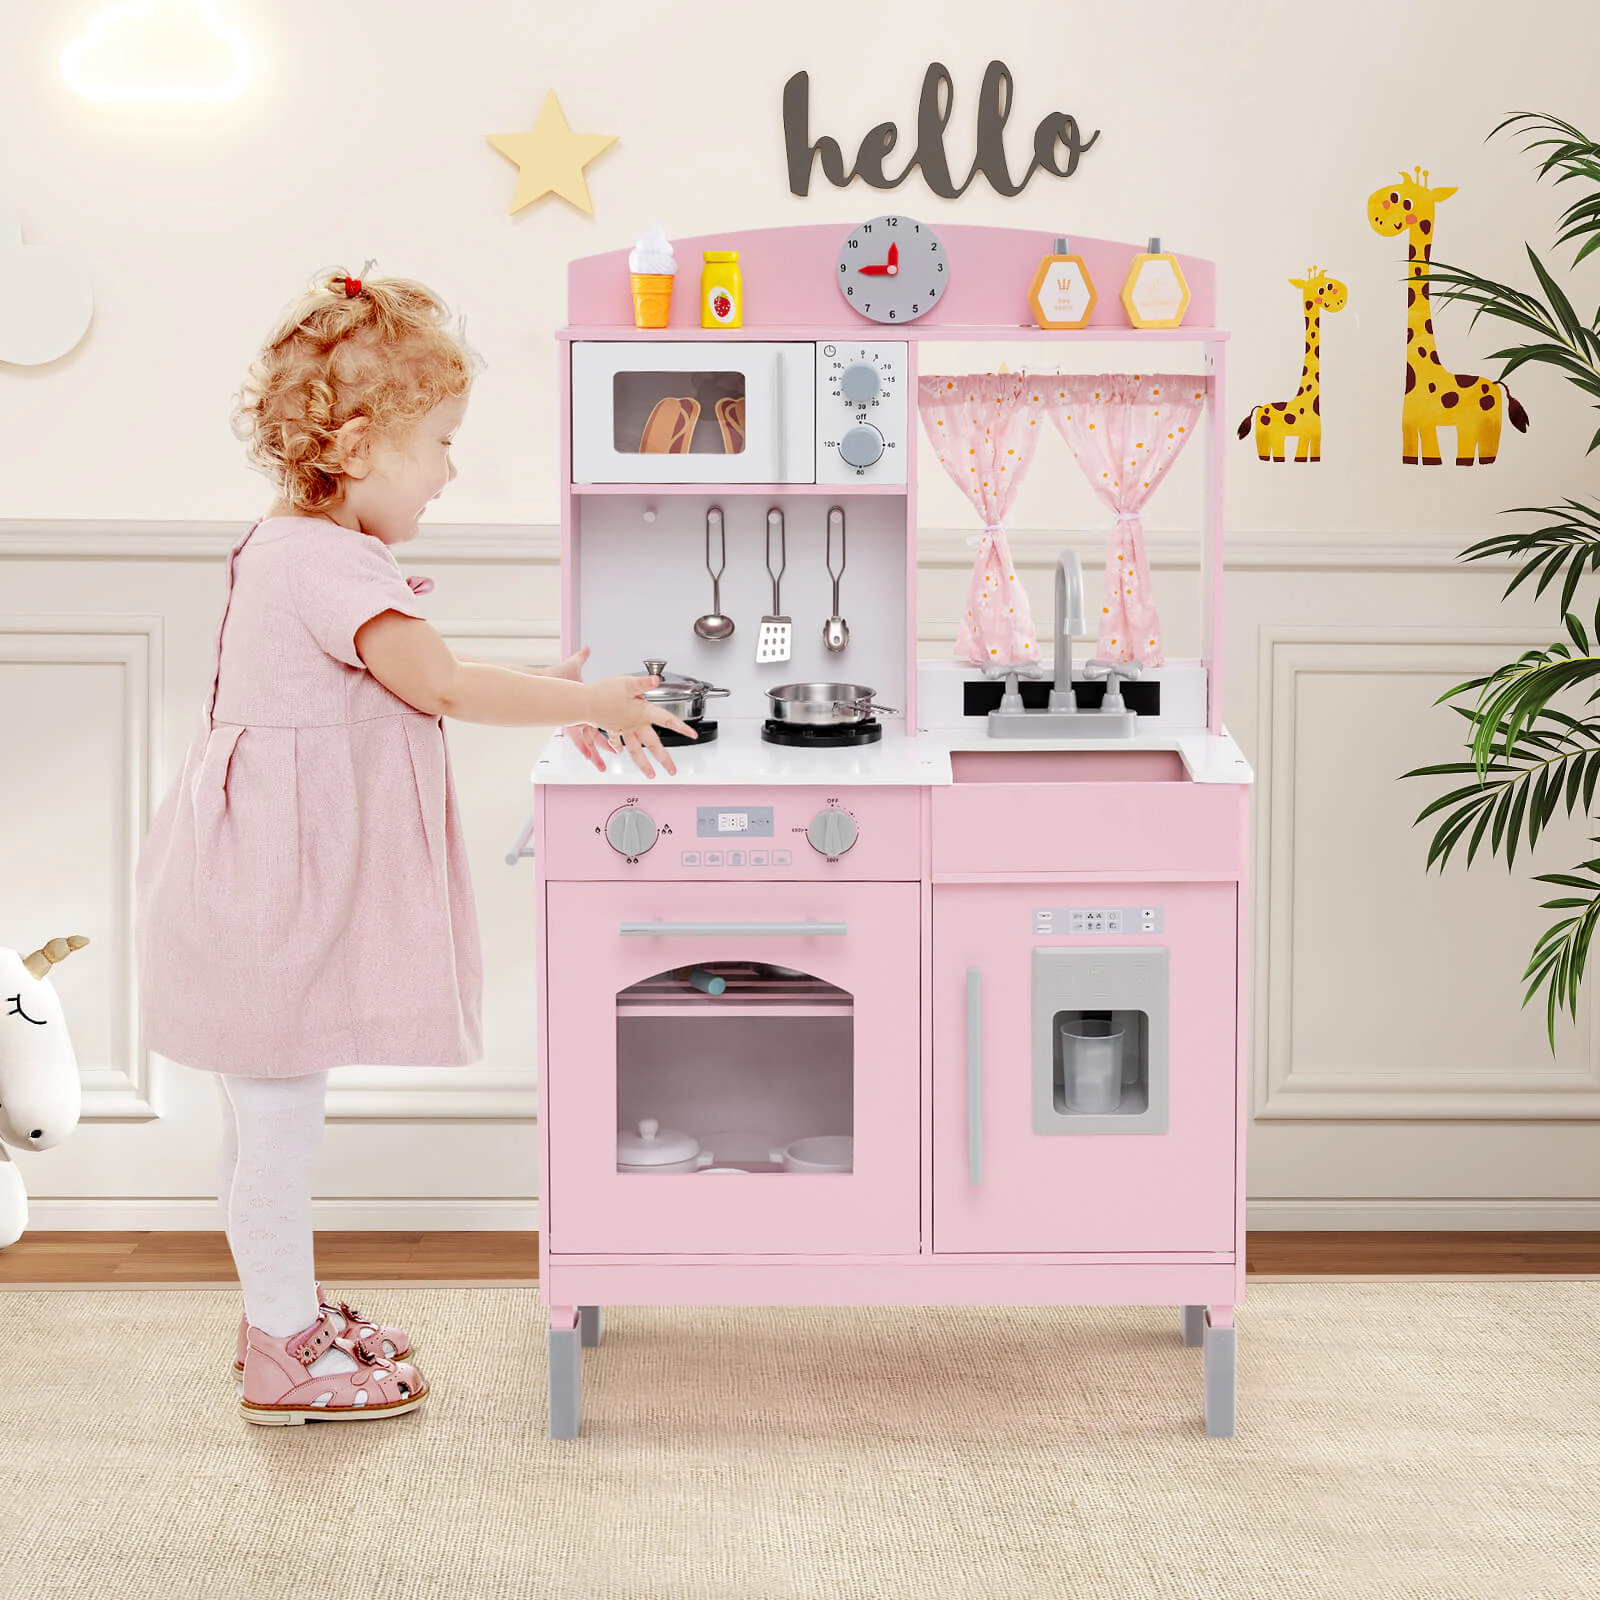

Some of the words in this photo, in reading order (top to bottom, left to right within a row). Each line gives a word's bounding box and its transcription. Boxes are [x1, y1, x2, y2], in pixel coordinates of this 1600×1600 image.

[783, 60, 1100, 199] hello
[886, 218, 898, 227] 12
[863, 224, 872, 233] 11
[914, 225, 919, 233] 1
[848, 240, 858, 249] 10
[931, 242, 937, 251] 2
[840, 263, 846, 272] 9
[937, 263, 943, 272] 3
[847, 286, 853, 296] 8
[929, 288, 935, 297] 4
[865, 303, 871, 312] 7
[912, 304, 919, 313] 5
[889, 310, 896, 319] 6
